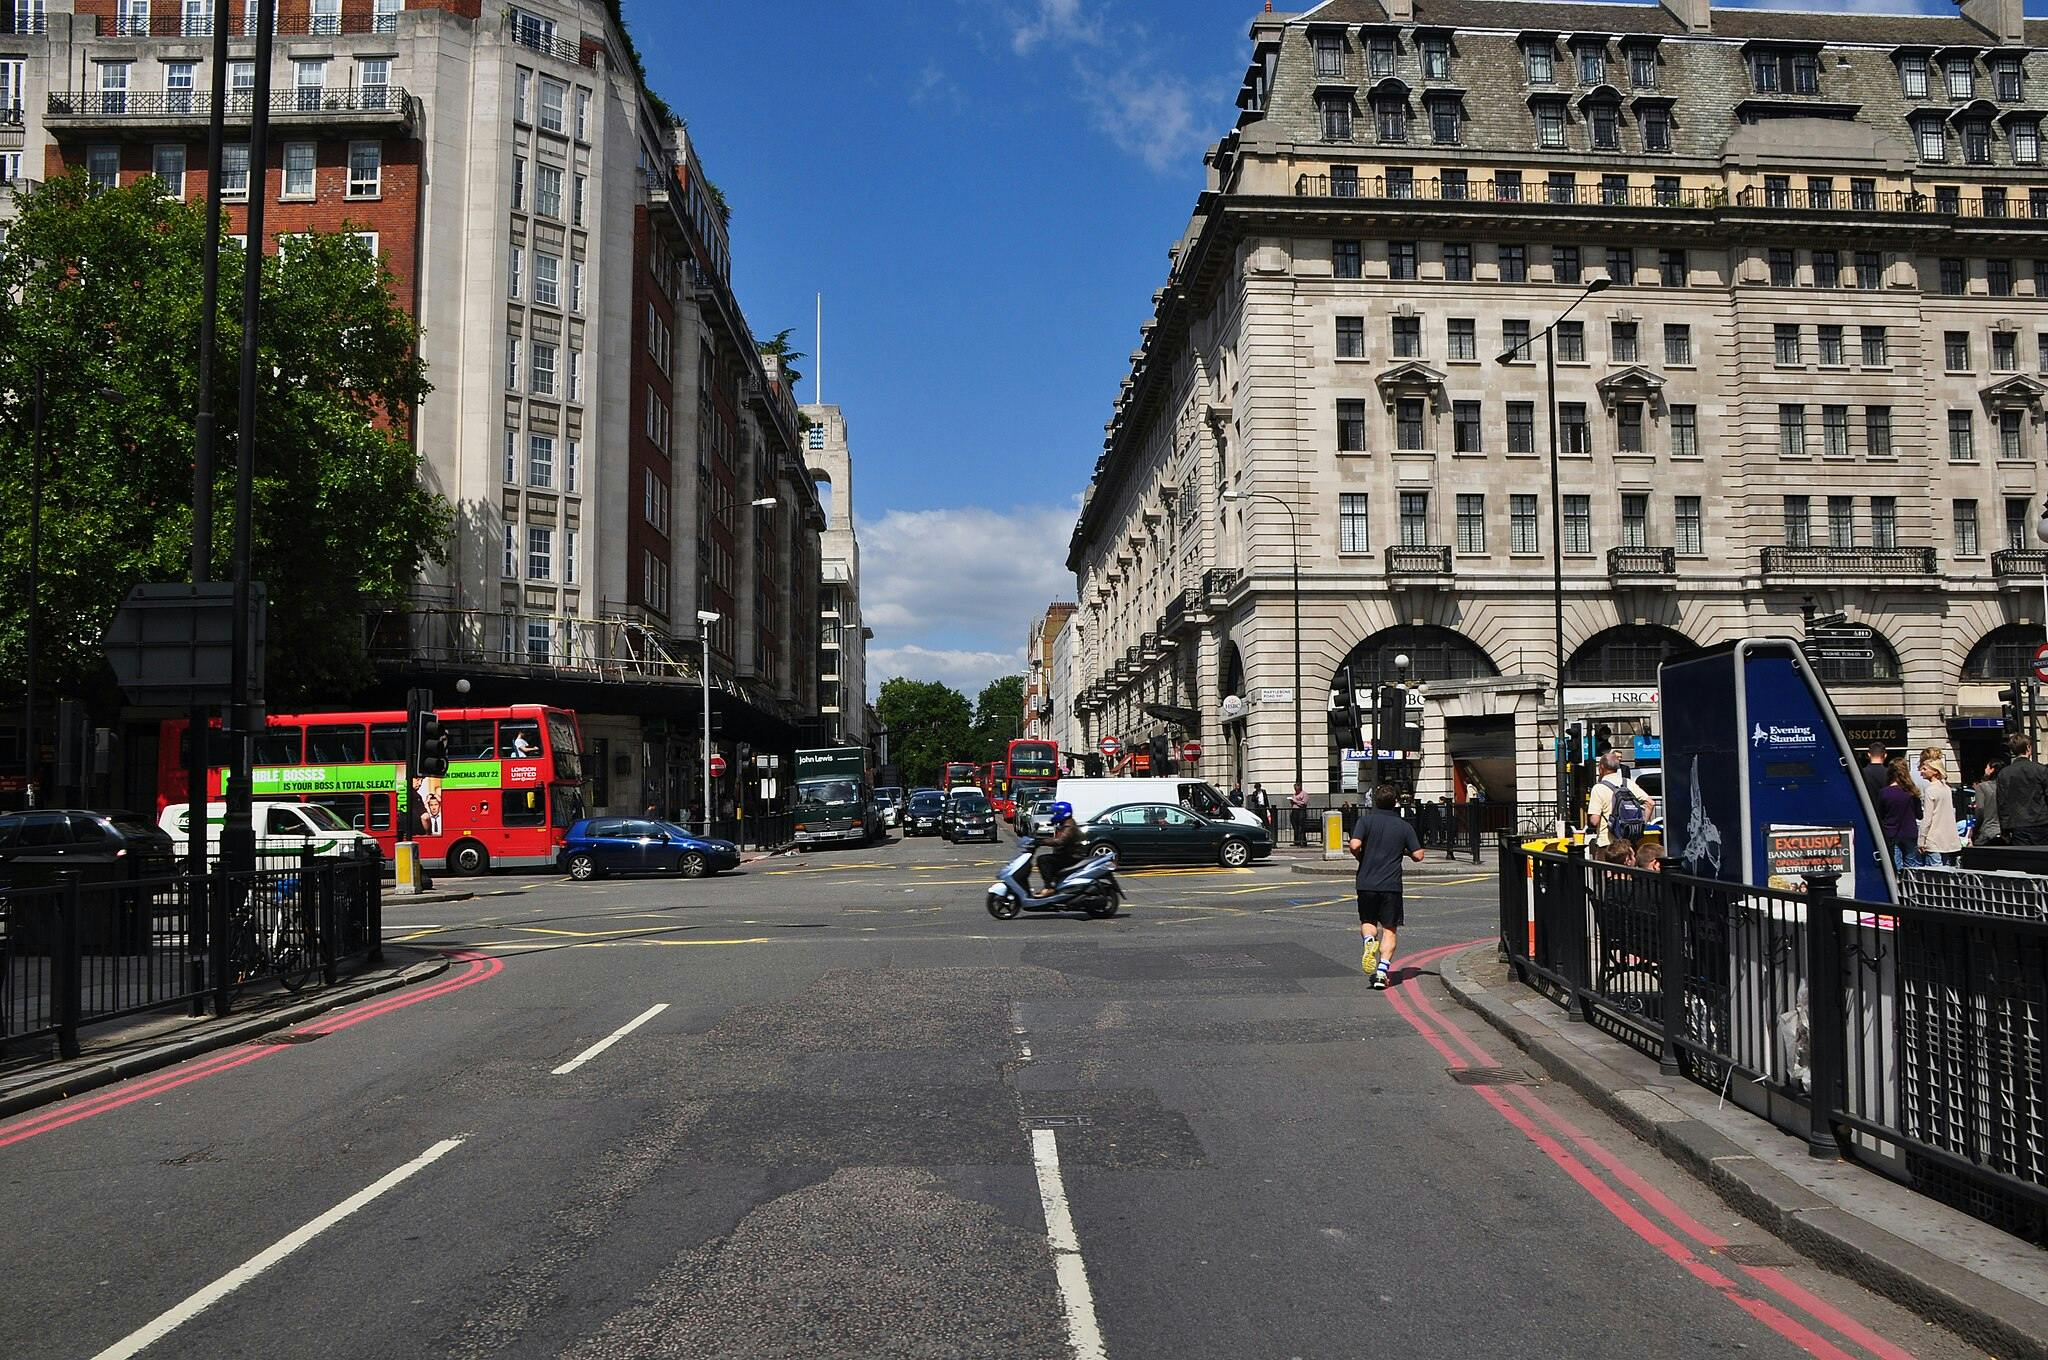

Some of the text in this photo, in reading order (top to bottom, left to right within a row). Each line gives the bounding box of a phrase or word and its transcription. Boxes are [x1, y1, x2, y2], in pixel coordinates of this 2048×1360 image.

[1612, 692, 1647, 703] HSBC
[1769, 725, 1810, 735] Evening
[1848, 729, 1897, 740] ssorize
[1769, 734, 1816, 743] Standard
[1350, 750, 1366, 758] BOX
[799, 755, 833, 765] John Lewis
[283, 768, 325, 781] BOSSES
[292, 782, 312, 791] YOUR
[314, 782, 334, 790] BOSS
[336, 781, 341, 789] A
[342, 781, 365, 789] TOTAL
[366, 780, 395, 788] SLEAZY
[1775, 836, 1842, 849] EXCLUSIVE
